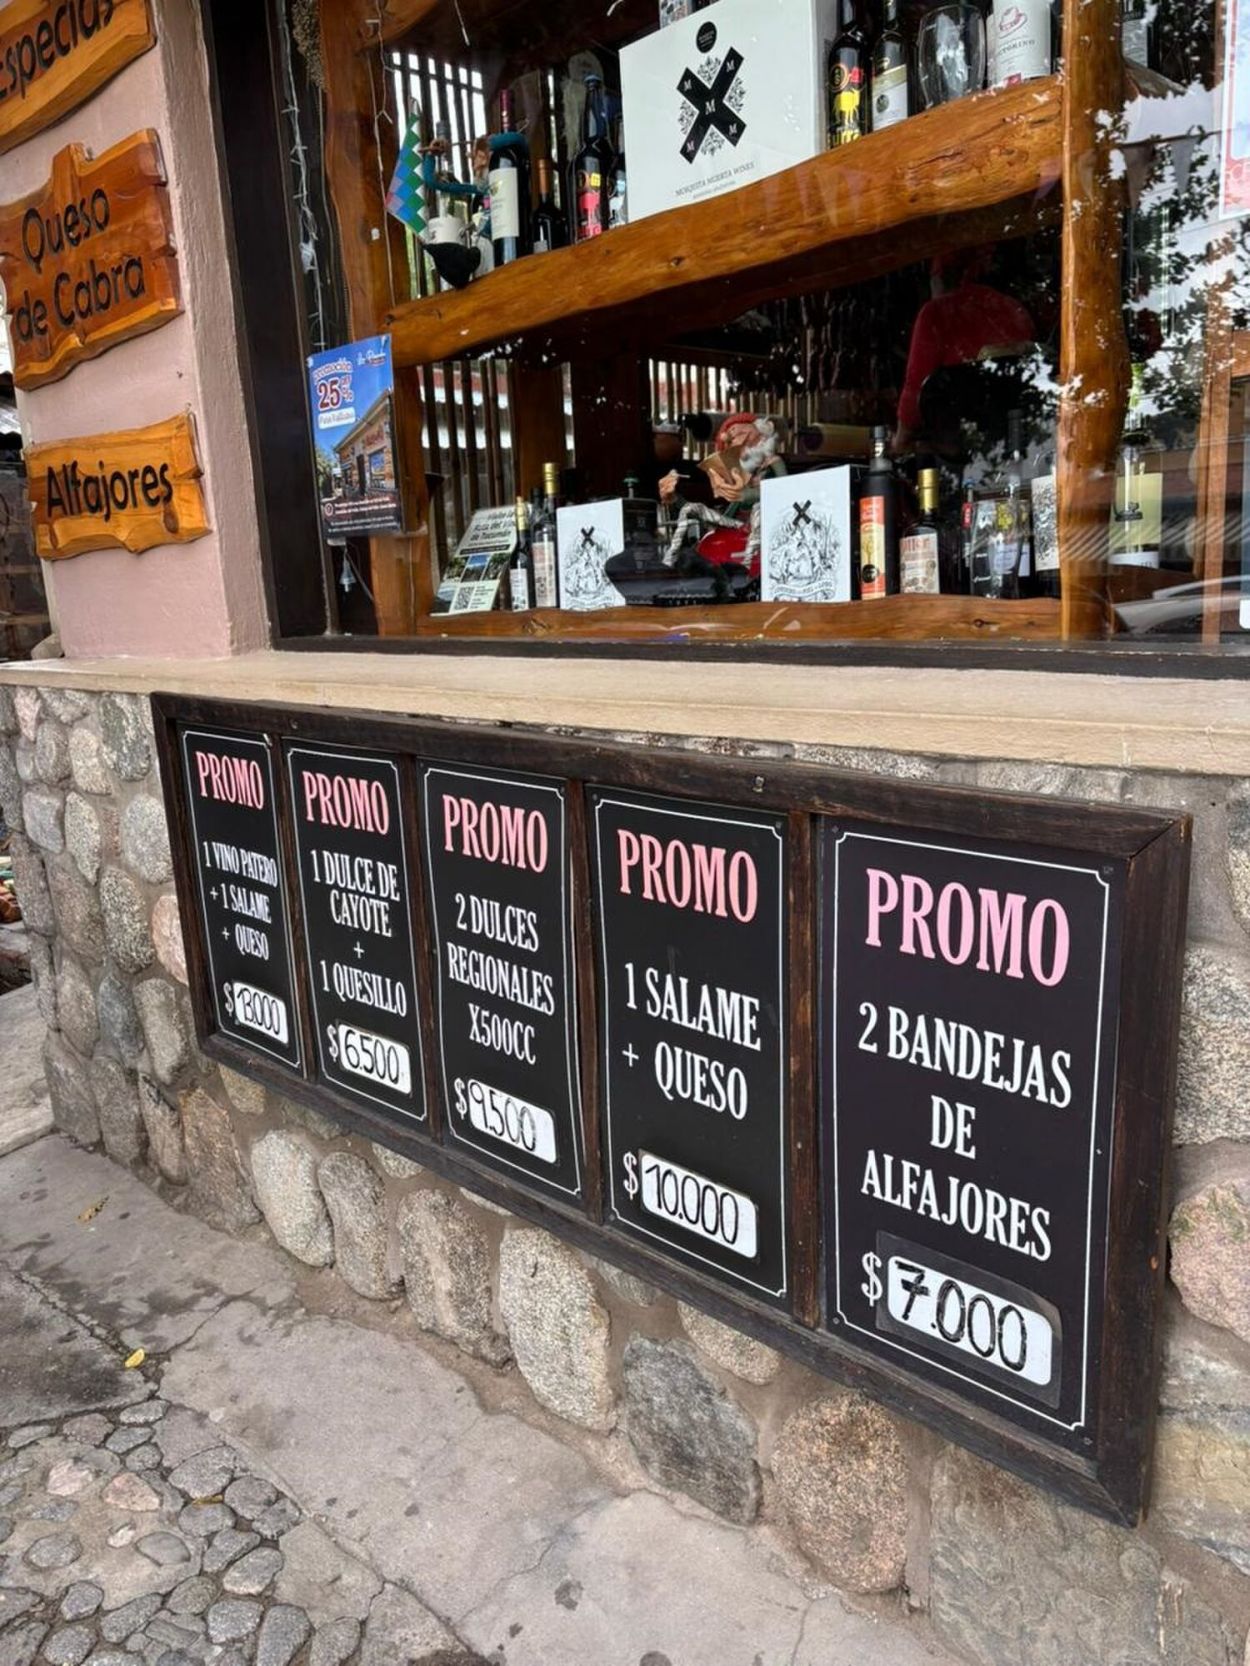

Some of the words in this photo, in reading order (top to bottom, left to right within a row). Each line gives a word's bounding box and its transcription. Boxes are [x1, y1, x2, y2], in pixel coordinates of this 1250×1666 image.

[22, 188, 109, 274] Queso
[15, 290, 48, 341] de
[54, 256, 146, 327] Cabra
[47, 461, 174, 521] Alfajores
[195, 751, 265, 811] PROMO
[302, 770, 390, 835] PROMO
[202, 841, 211, 868] 1
[212, 841, 240, 874] VINO
[239, 849, 278, 888] PATERO
[442, 794, 548, 873] PROMO
[220, 883, 229, 910] 1
[230, 884, 272, 924] SALAME
[311, 850, 321, 883] 1
[322, 850, 376, 895] DULCE
[377, 861, 400, 902] DE
[617, 829, 758, 923] PROMO
[222, 927, 230, 940] +
[234, 923, 270, 961] QUESO
[330, 889, 392, 938] CAYOTE
[455, 892, 467, 931] 2
[469, 894, 539, 952] DULCES
[865, 867, 1070, 987] PROMO
[353, 941, 365, 959] +
[446, 941, 555, 1016] REGIONALES
[320, 959, 330, 992] 1
[333, 962, 407, 1017] QUESILLO
[625, 962, 638, 1009] 1
[645, 967, 761, 1052] SALAME
[468, 1002, 536, 1065] X500CC
[858, 1001, 878, 1053] 2
[888, 1005, 1072, 1109] BANDEJAS
[622, 1043, 639, 1067] +
[654, 1041, 748, 1120] QUESO
[930, 1095, 976, 1160] DE
[860, 1149, 1051, 1262] ALFAJORES
